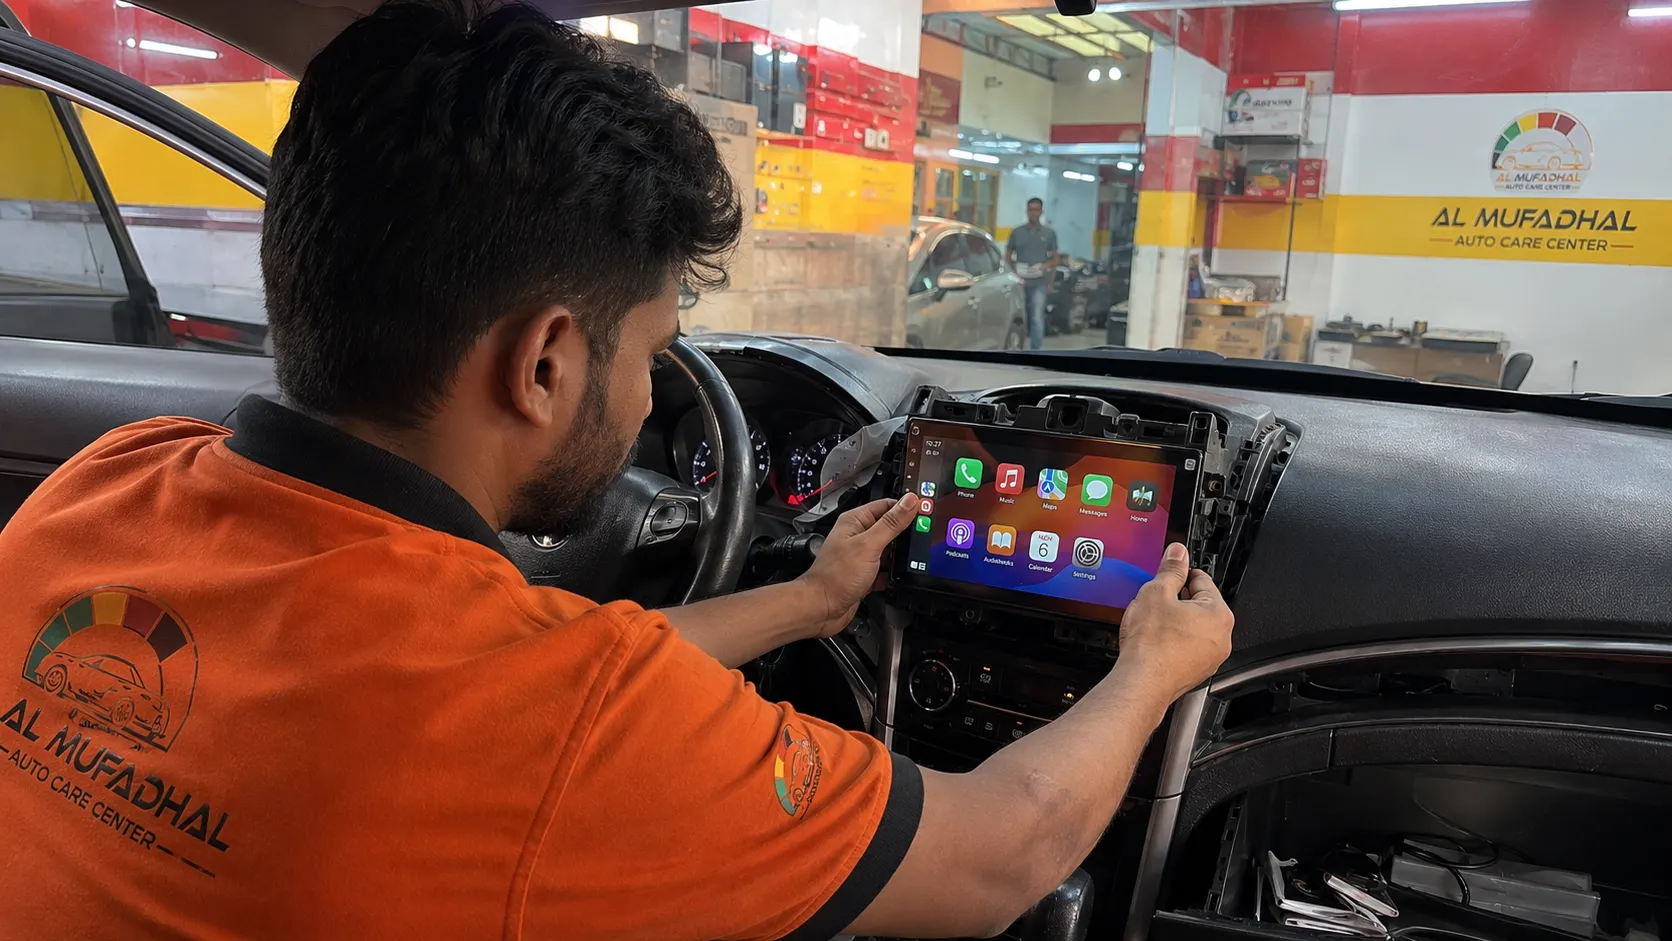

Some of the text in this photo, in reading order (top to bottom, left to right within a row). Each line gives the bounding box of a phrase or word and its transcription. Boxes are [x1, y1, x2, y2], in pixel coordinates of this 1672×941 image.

[1495, 172, 1582, 183] AL MUFADHAL
[1431, 207, 1638, 232] AL MUFADHAL
[1454, 235, 1608, 251] AUTO CARE CENTER
[957, 490, 975, 498] Phone
[999, 496, 1015, 504] Music
[1079, 507, 1108, 517] Messages
[1130, 514, 1148, 523] Home
[1038, 542, 1049, 557] 6
[1028, 563, 1053, 573] Calendar
[1072, 570, 1096, 580] Settings
[0, 698, 230, 852] AL MUFADHAL
[8, 748, 157, 850] AUTO CARE CENTER
